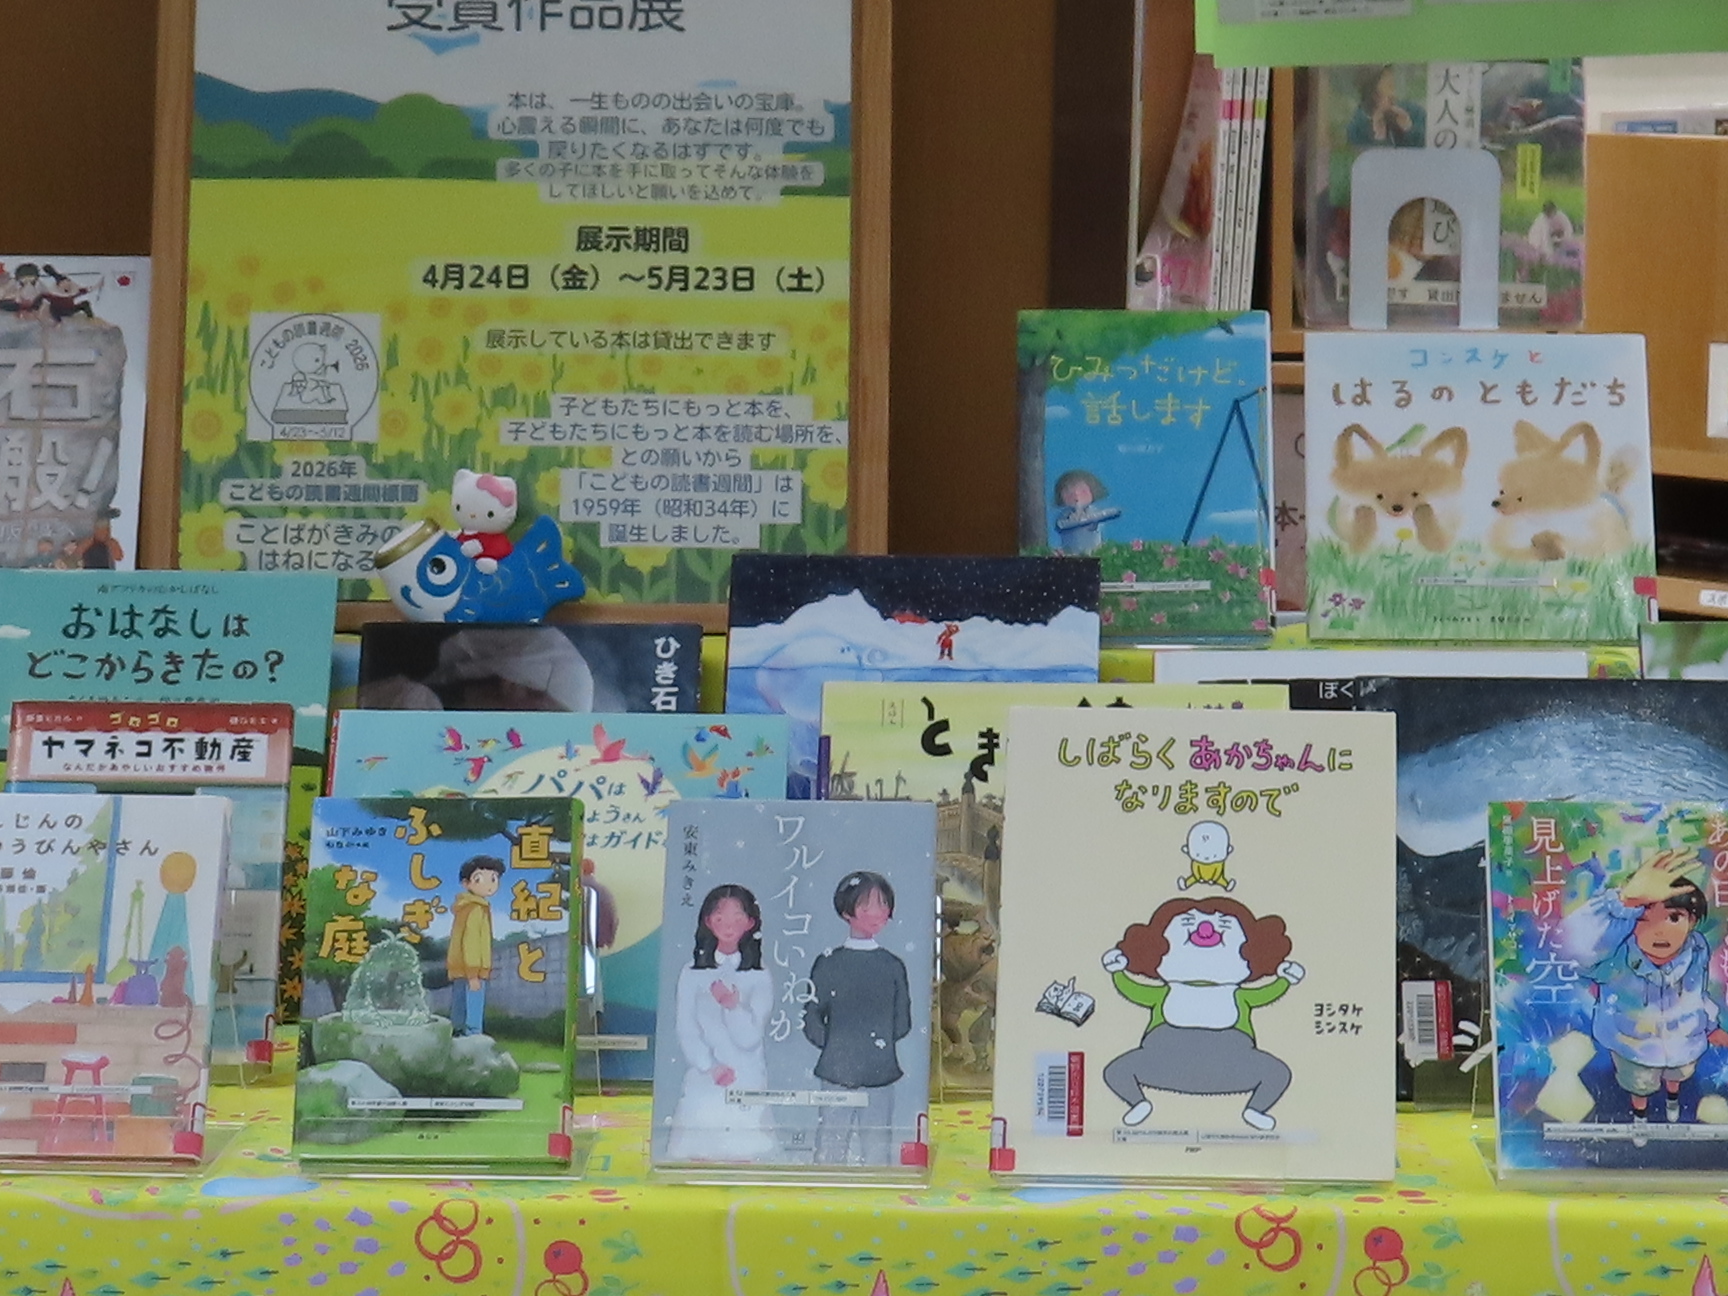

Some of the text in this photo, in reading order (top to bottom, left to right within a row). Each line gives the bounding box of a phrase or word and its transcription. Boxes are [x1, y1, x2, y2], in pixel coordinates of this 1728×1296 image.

[574, 224, 690, 255] 展示期間
[344, 338, 370, 372] 2026
[484, 327, 778, 354] 展示している本は貸出できます
[1409, 347, 1544, 370] コンスケと
[1330, 376, 1627, 410] はるのともだち
[559, 397, 792, 419] 子どもたちにもっと本を、
[1080, 390, 1212, 430] 話します
[507, 420, 844, 444] 子どもたちにもっと本を読む場所を、
[291, 459, 358, 479] 2026年
[620, 447, 742, 468] との願いから
[578, 472, 794, 494] 「こどもの読書週間」は
[237, 523, 401, 546] ことばがきみの
[608, 522, 742, 546] 誕生しました。
[257, 550, 376, 572] はねになる
[61, 603, 251, 641] おはなしは
[650, 635, 683, 712] ひき石
[109, 710, 180, 729] ゴロゴロ
[42, 735, 256, 763] ヤマネコ不動産
[523, 769, 627, 801] パパは
[1114, 778, 1301, 816] なりますので
[394, 805, 448, 945] ふしぎ
[680, 823, 701, 909] 安東みきえ
[318, 863, 378, 964] な庭
[509, 823, 564, 985] 直紀と
[1523, 815, 1580, 1005] 見上げた空
[768, 814, 825, 1043] ワルイコいねが
[1313, 1003, 1363, 1019] ヨシタケ
[1313, 1020, 1363, 1036] シンスケ
